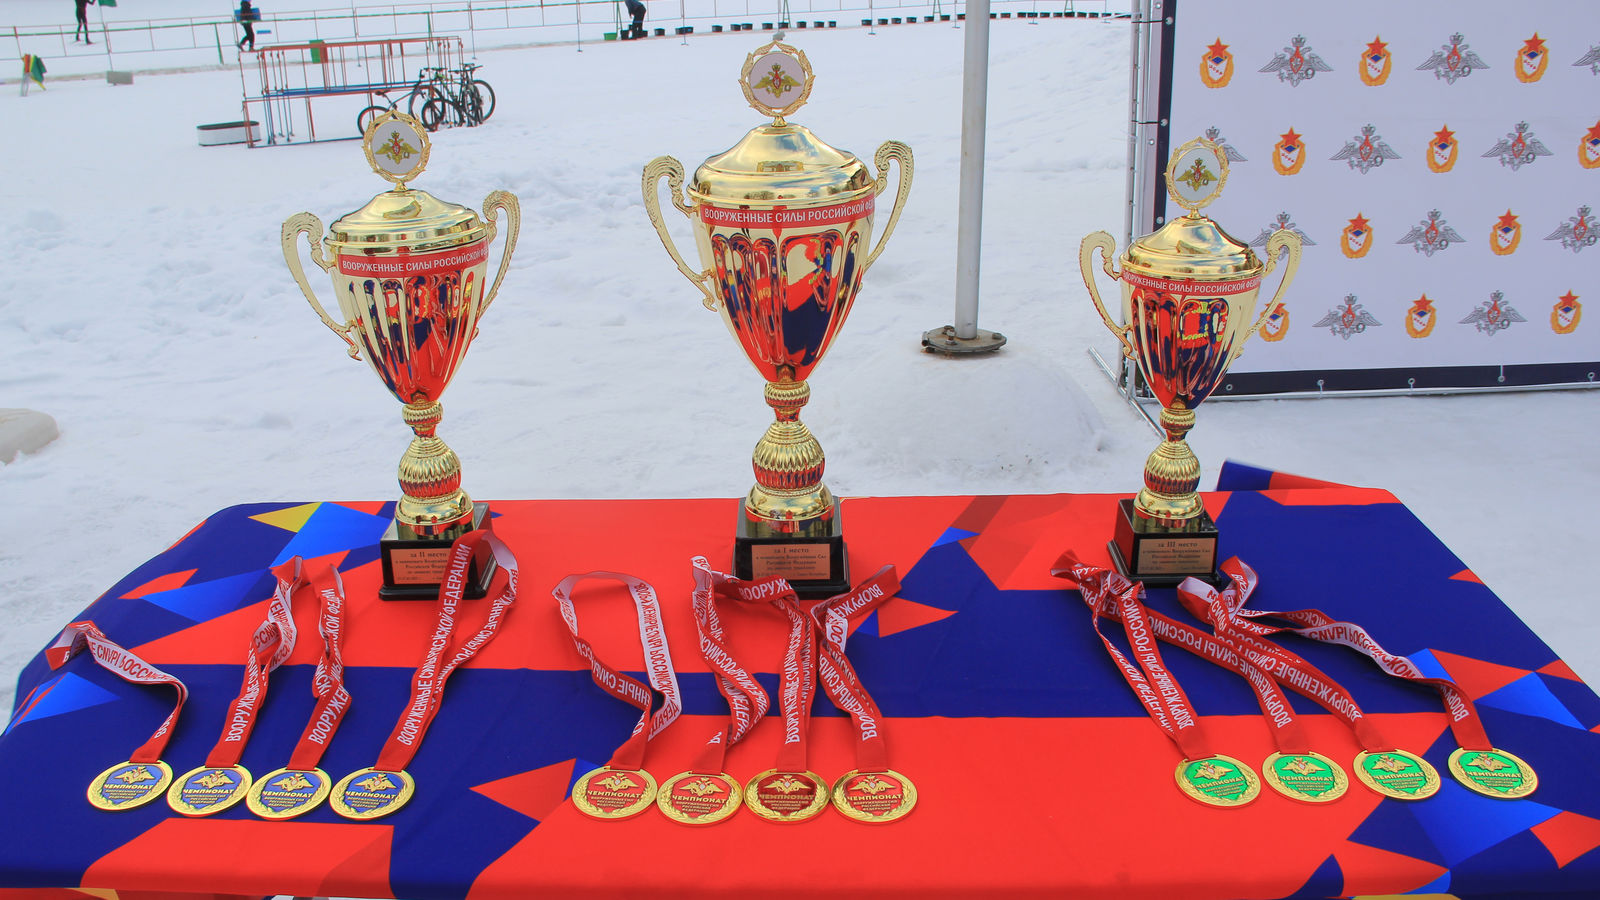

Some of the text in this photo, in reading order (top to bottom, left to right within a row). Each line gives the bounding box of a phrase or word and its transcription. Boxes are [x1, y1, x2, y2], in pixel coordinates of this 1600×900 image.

[704, 208, 773, 223] ВООРУЖЕННЫЕ
[775, 210, 806, 222] СИЛЫ
[808, 201, 864, 221] РОССИЙСКОЙ
[342, 260, 404, 273] ВООРУЖЕННЫЕ
[406, 260, 432, 271] СИЛЫ
[1168, 283, 1193, 293] СИЛЫ
[1194, 281, 1245, 293] РОССИЙСКОЙ
[442, 543, 471, 612] ФЕДЕРАЦИИ
[1203, 640, 1238, 666] СИЛЫ
[1275, 661, 1362, 722] ВООРУЖЕННЫЕ
[1195, 776, 1245, 789] ЧЕМПИОНАТ
[345, 791, 396, 799] ЧЕМПИОНАТ
[587, 790, 641, 798] ЧЕМПИОНАТ
[672, 795, 727, 803] ЧЕМПИОНАТ
